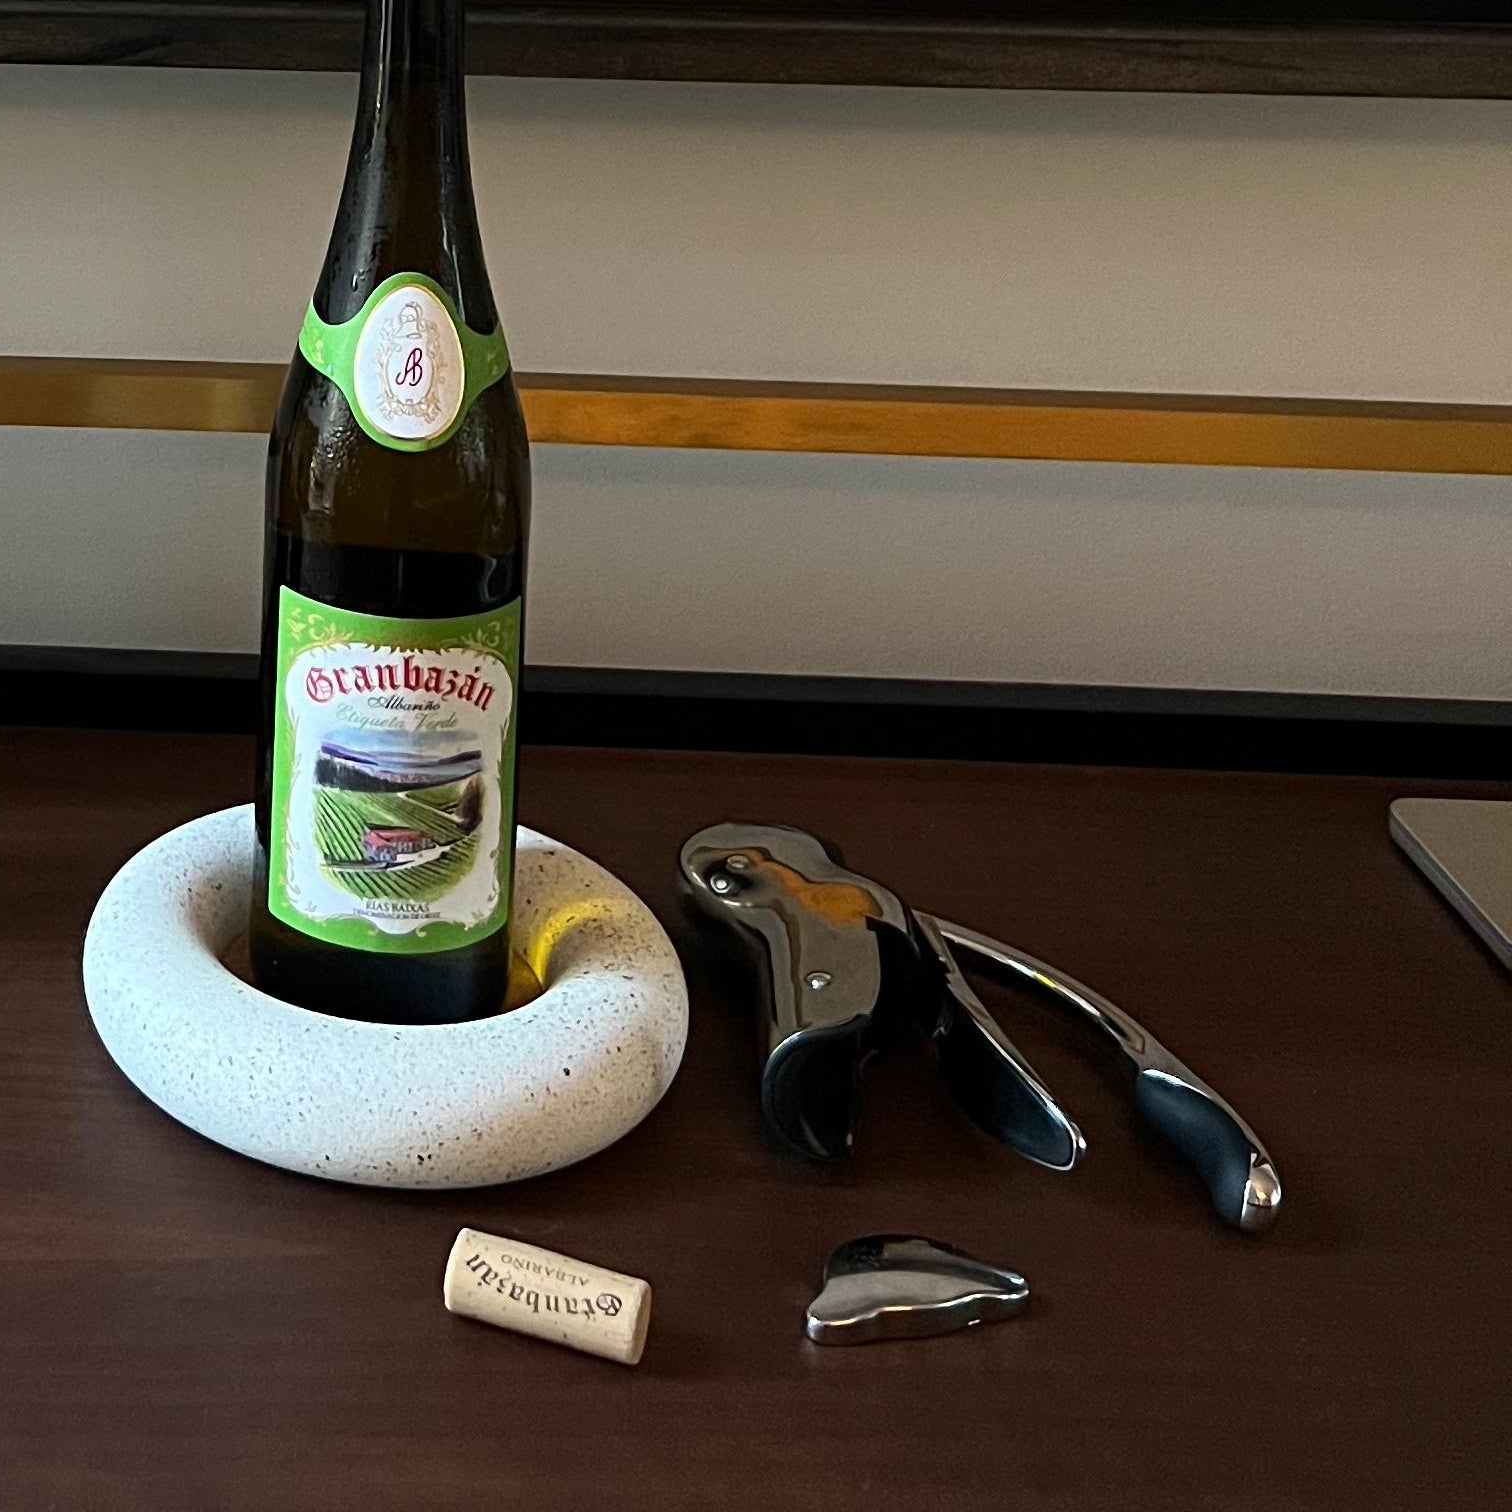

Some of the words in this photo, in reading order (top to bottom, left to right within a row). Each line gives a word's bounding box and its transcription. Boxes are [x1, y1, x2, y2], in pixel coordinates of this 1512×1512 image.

[306, 656, 495, 712] Granbazán
[367, 694, 442, 712] Albariño
[465, 1254, 623, 1320] Granbazán
